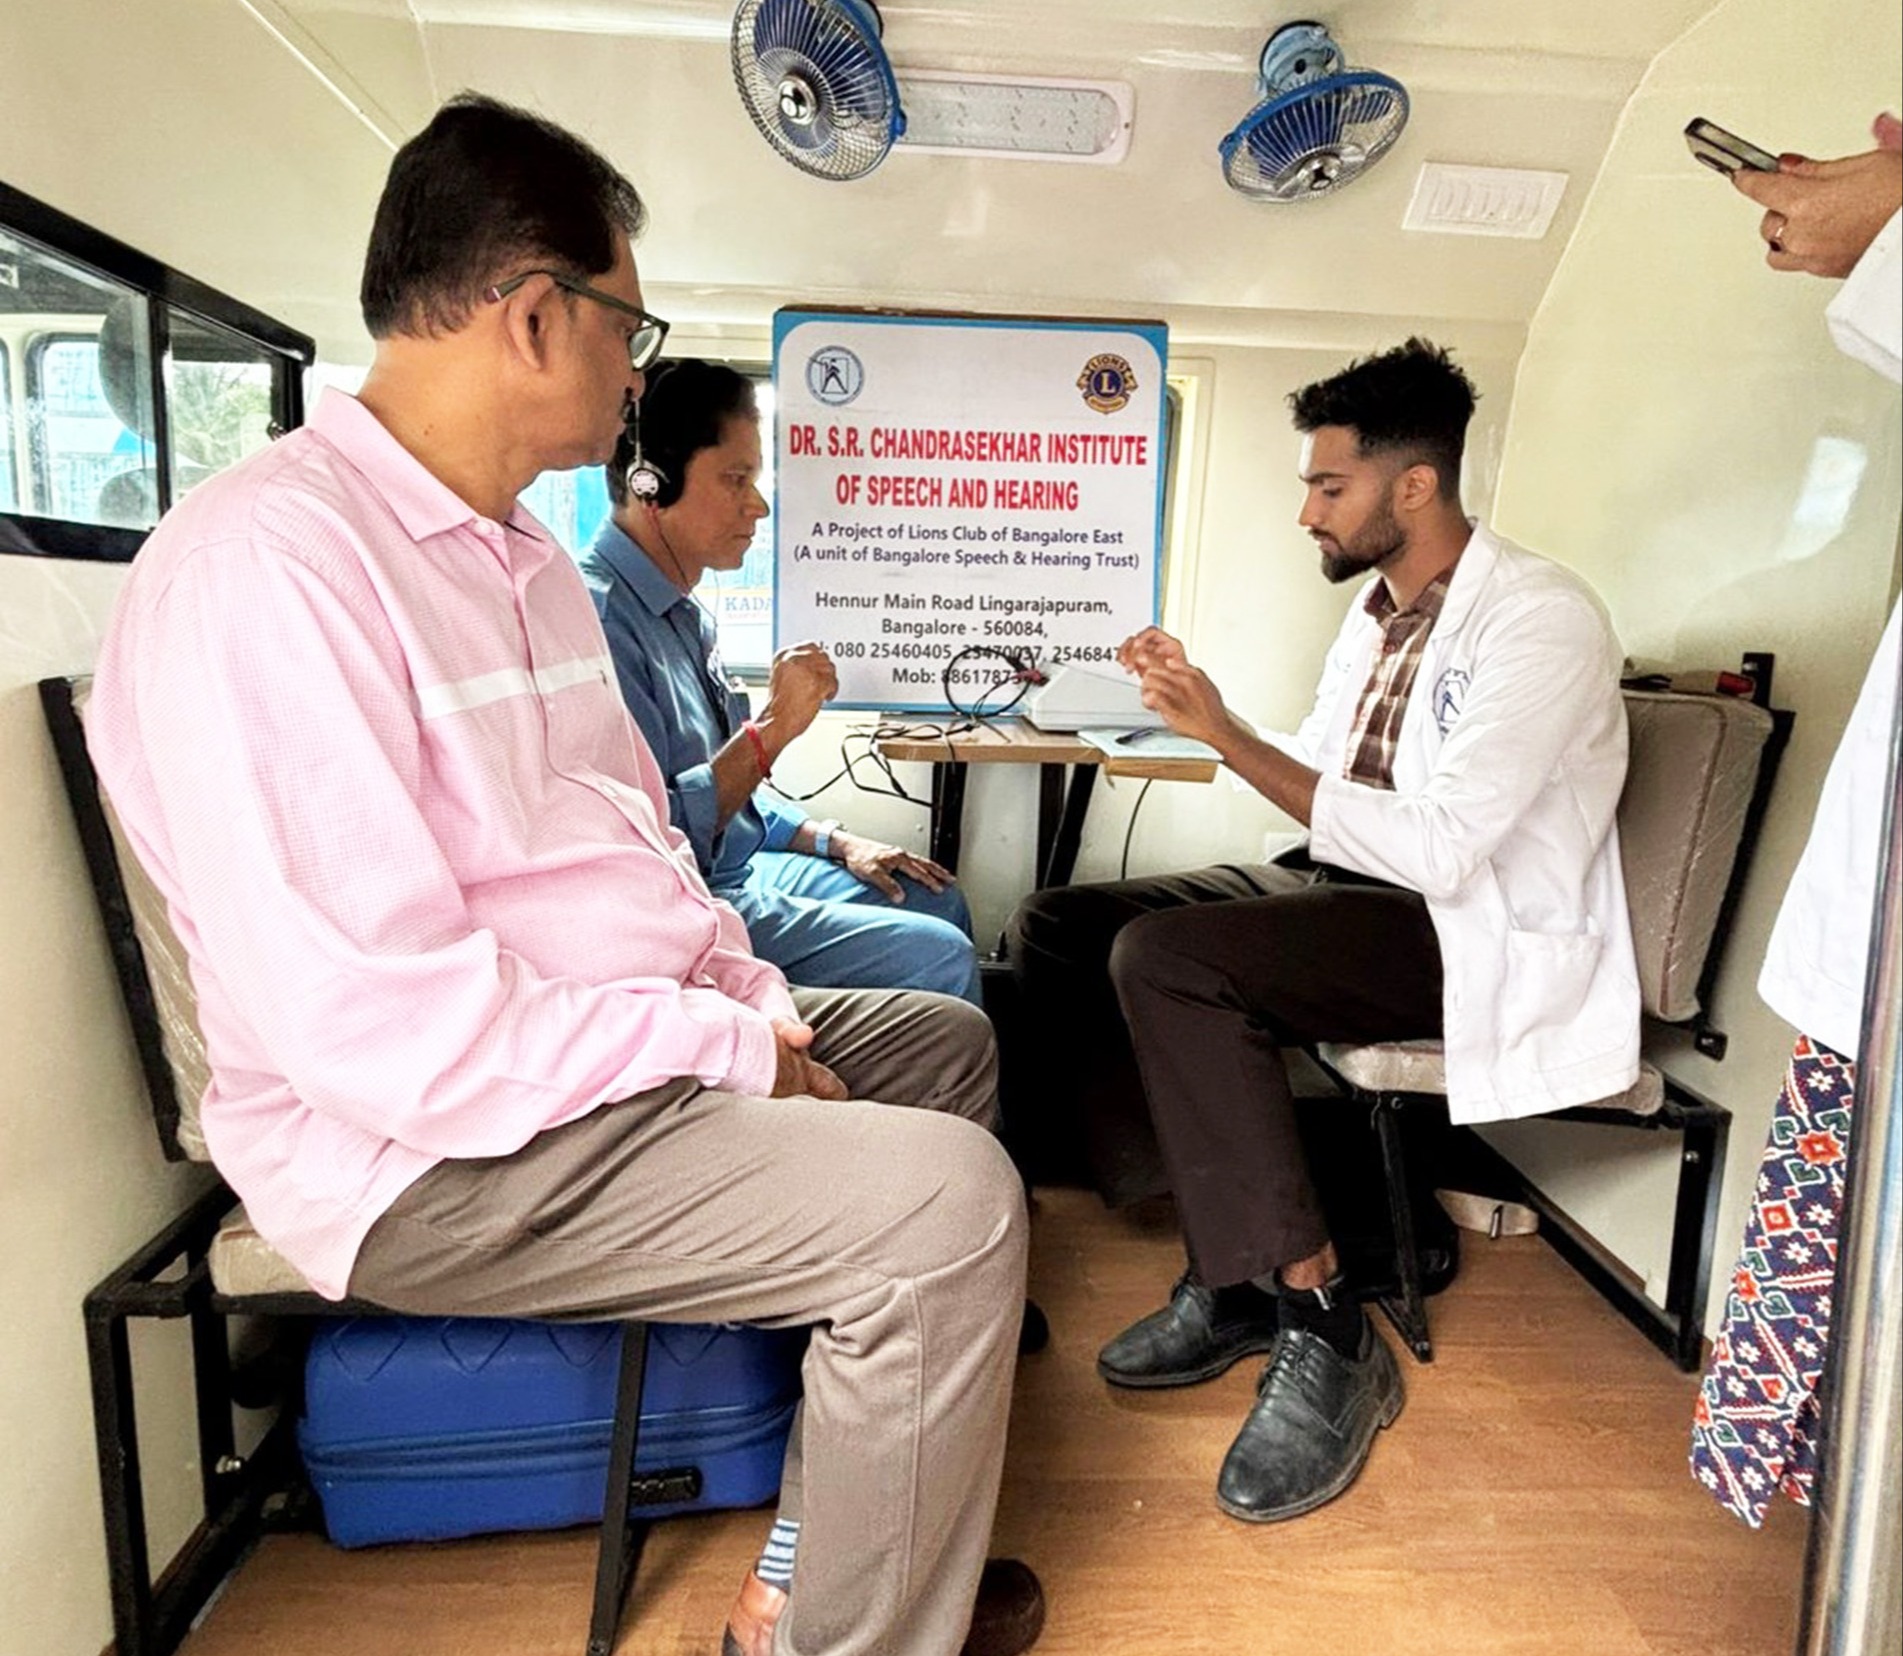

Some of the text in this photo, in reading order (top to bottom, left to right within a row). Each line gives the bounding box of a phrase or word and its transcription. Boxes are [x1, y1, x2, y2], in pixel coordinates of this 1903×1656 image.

[1101, 373, 1116, 393] L
[790, 425, 1147, 465] DR. S.R. CHANDRASEKHAR INSTITUTE
[836, 474, 1078, 511] OF SPEECH AND HEARING
[811, 522, 1123, 547] A Project of Lions Club of Bangalore East
[794, 545, 1139, 571] (A unit of Bangalore Speech & Hearing Trust)
[816, 592, 1112, 616] Hennur Main Road Lingarajapuram,
[882, 618, 966, 639] Bangalore
[984, 620, 1048, 638] 560084,
[834, 642, 865, 658] 080
[892, 668, 935, 683] Mob:
